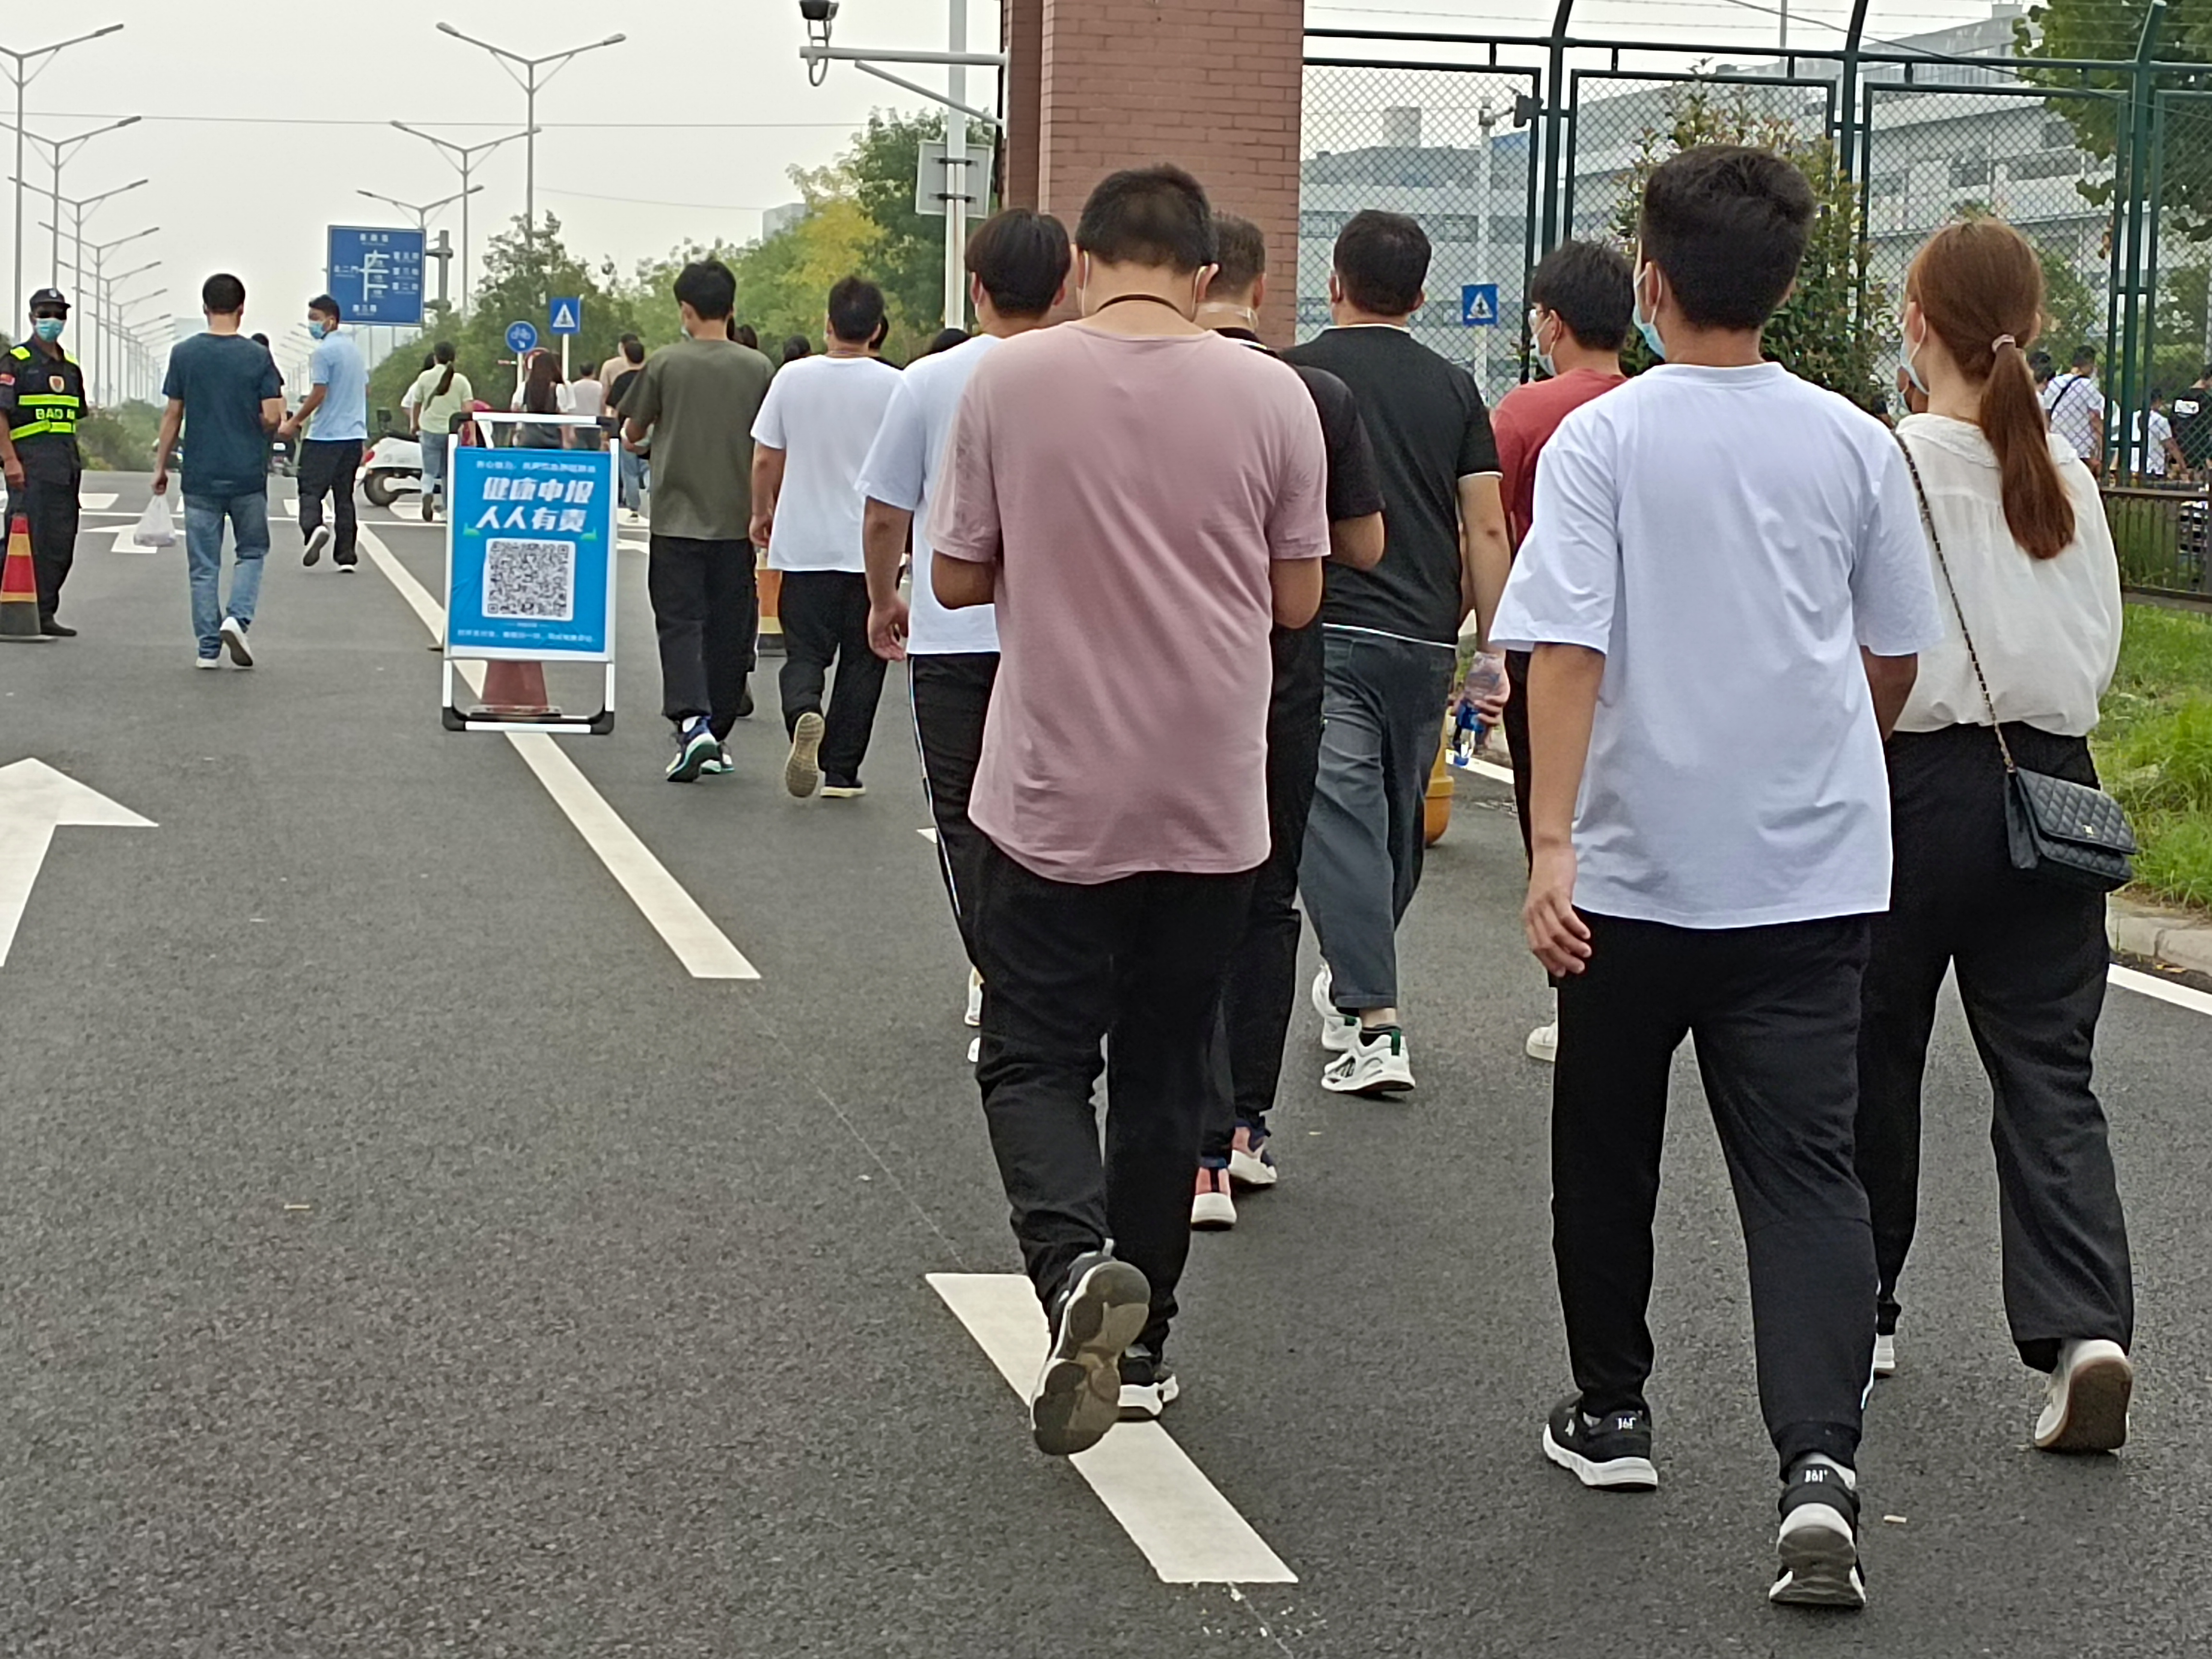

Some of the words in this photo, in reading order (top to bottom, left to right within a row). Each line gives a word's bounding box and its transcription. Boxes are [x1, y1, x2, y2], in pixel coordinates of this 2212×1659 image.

[482, 476, 594, 504] 健康申报
[475, 505, 588, 532] 人人有责
